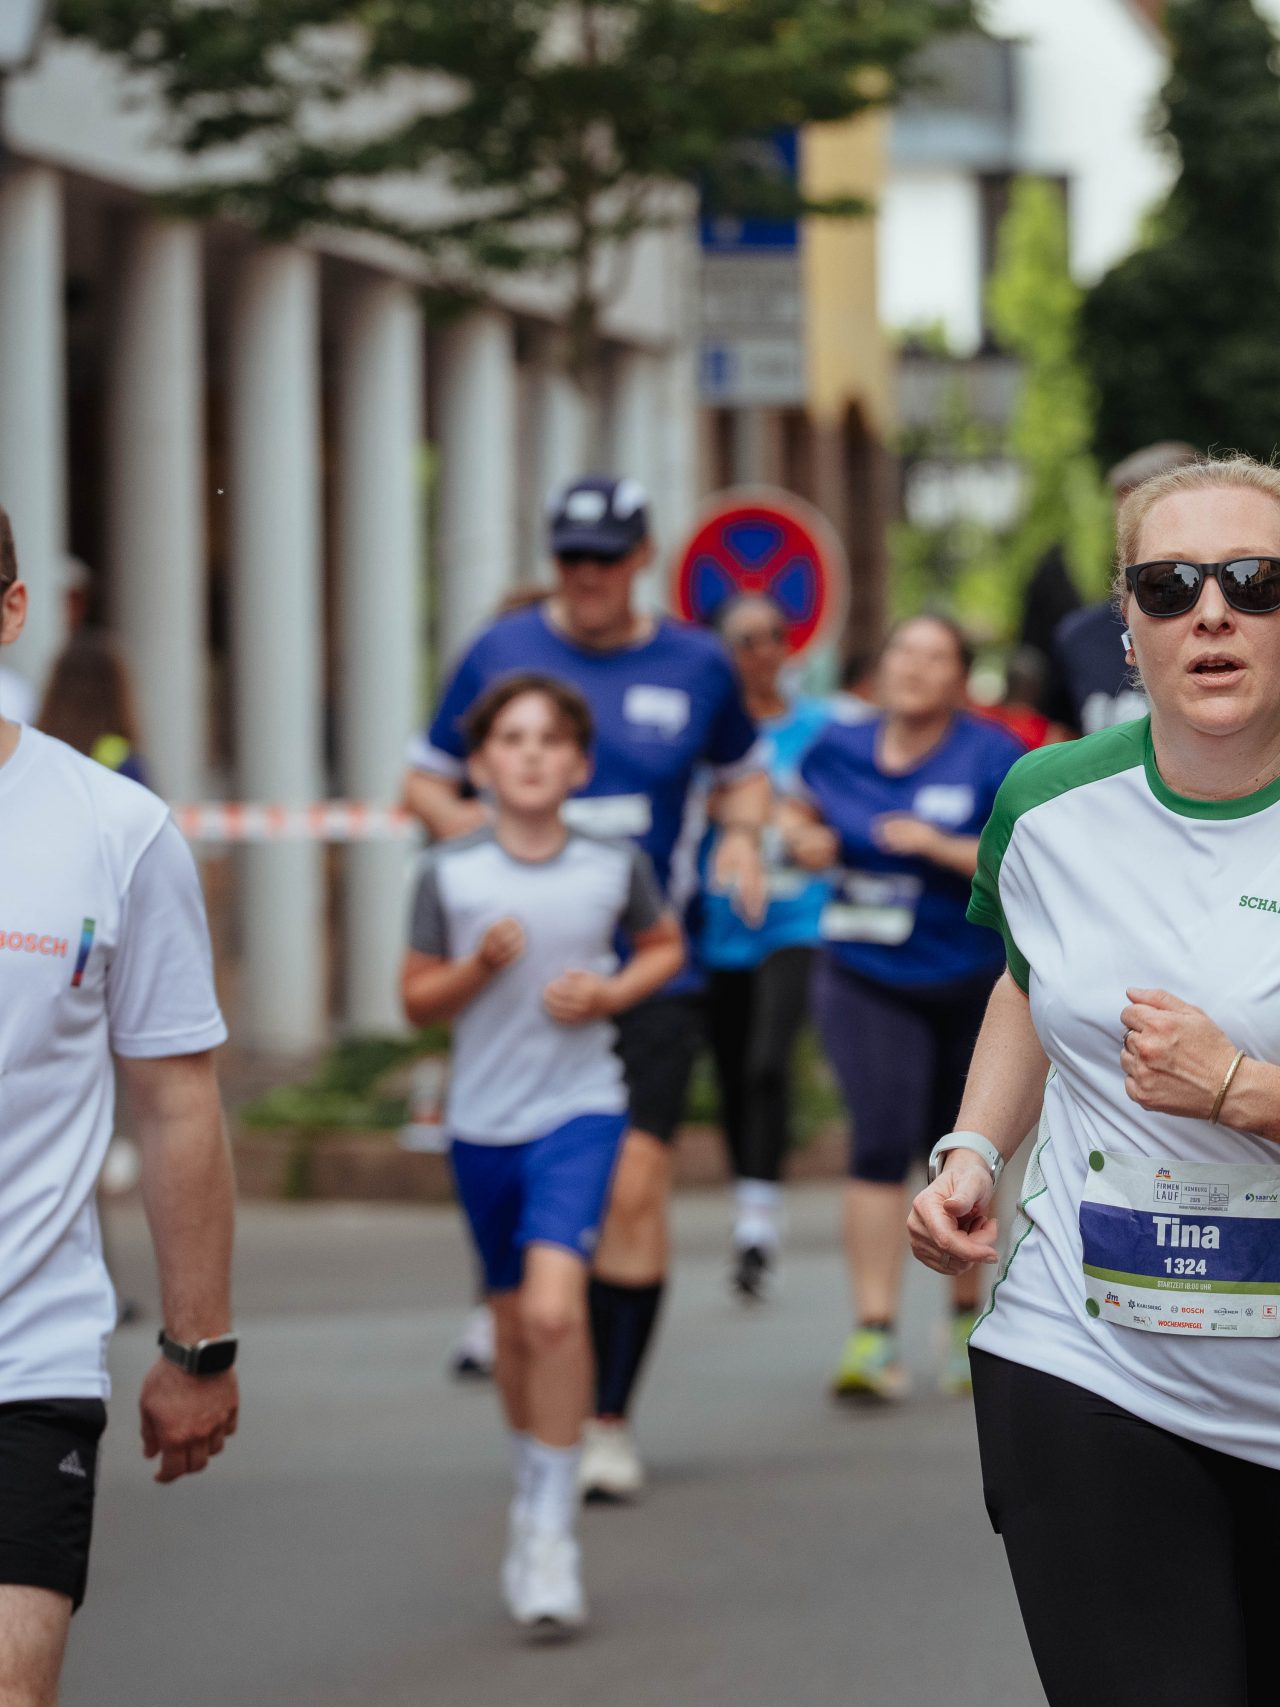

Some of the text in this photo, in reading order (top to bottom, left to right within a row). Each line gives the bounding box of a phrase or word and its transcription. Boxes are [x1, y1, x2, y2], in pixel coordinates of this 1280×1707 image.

[1157, 1167, 1170, 1176] dm
[1157, 1183, 1180, 1191] FIRMEN
[1157, 1191, 1179, 1200] LAUF
[1153, 1216, 1220, 1249] Tina
[1164, 1257, 1207, 1276] 1324
[1157, 1280, 1184, 1290] STARTZEIT
[1200, 1283, 1212, 1291] UHR
[1106, 1291, 1119, 1301] dm
[1181, 1307, 1205, 1315] BOSCH
[1157, 1319, 1203, 1330] WOCHENSPIEGEL
